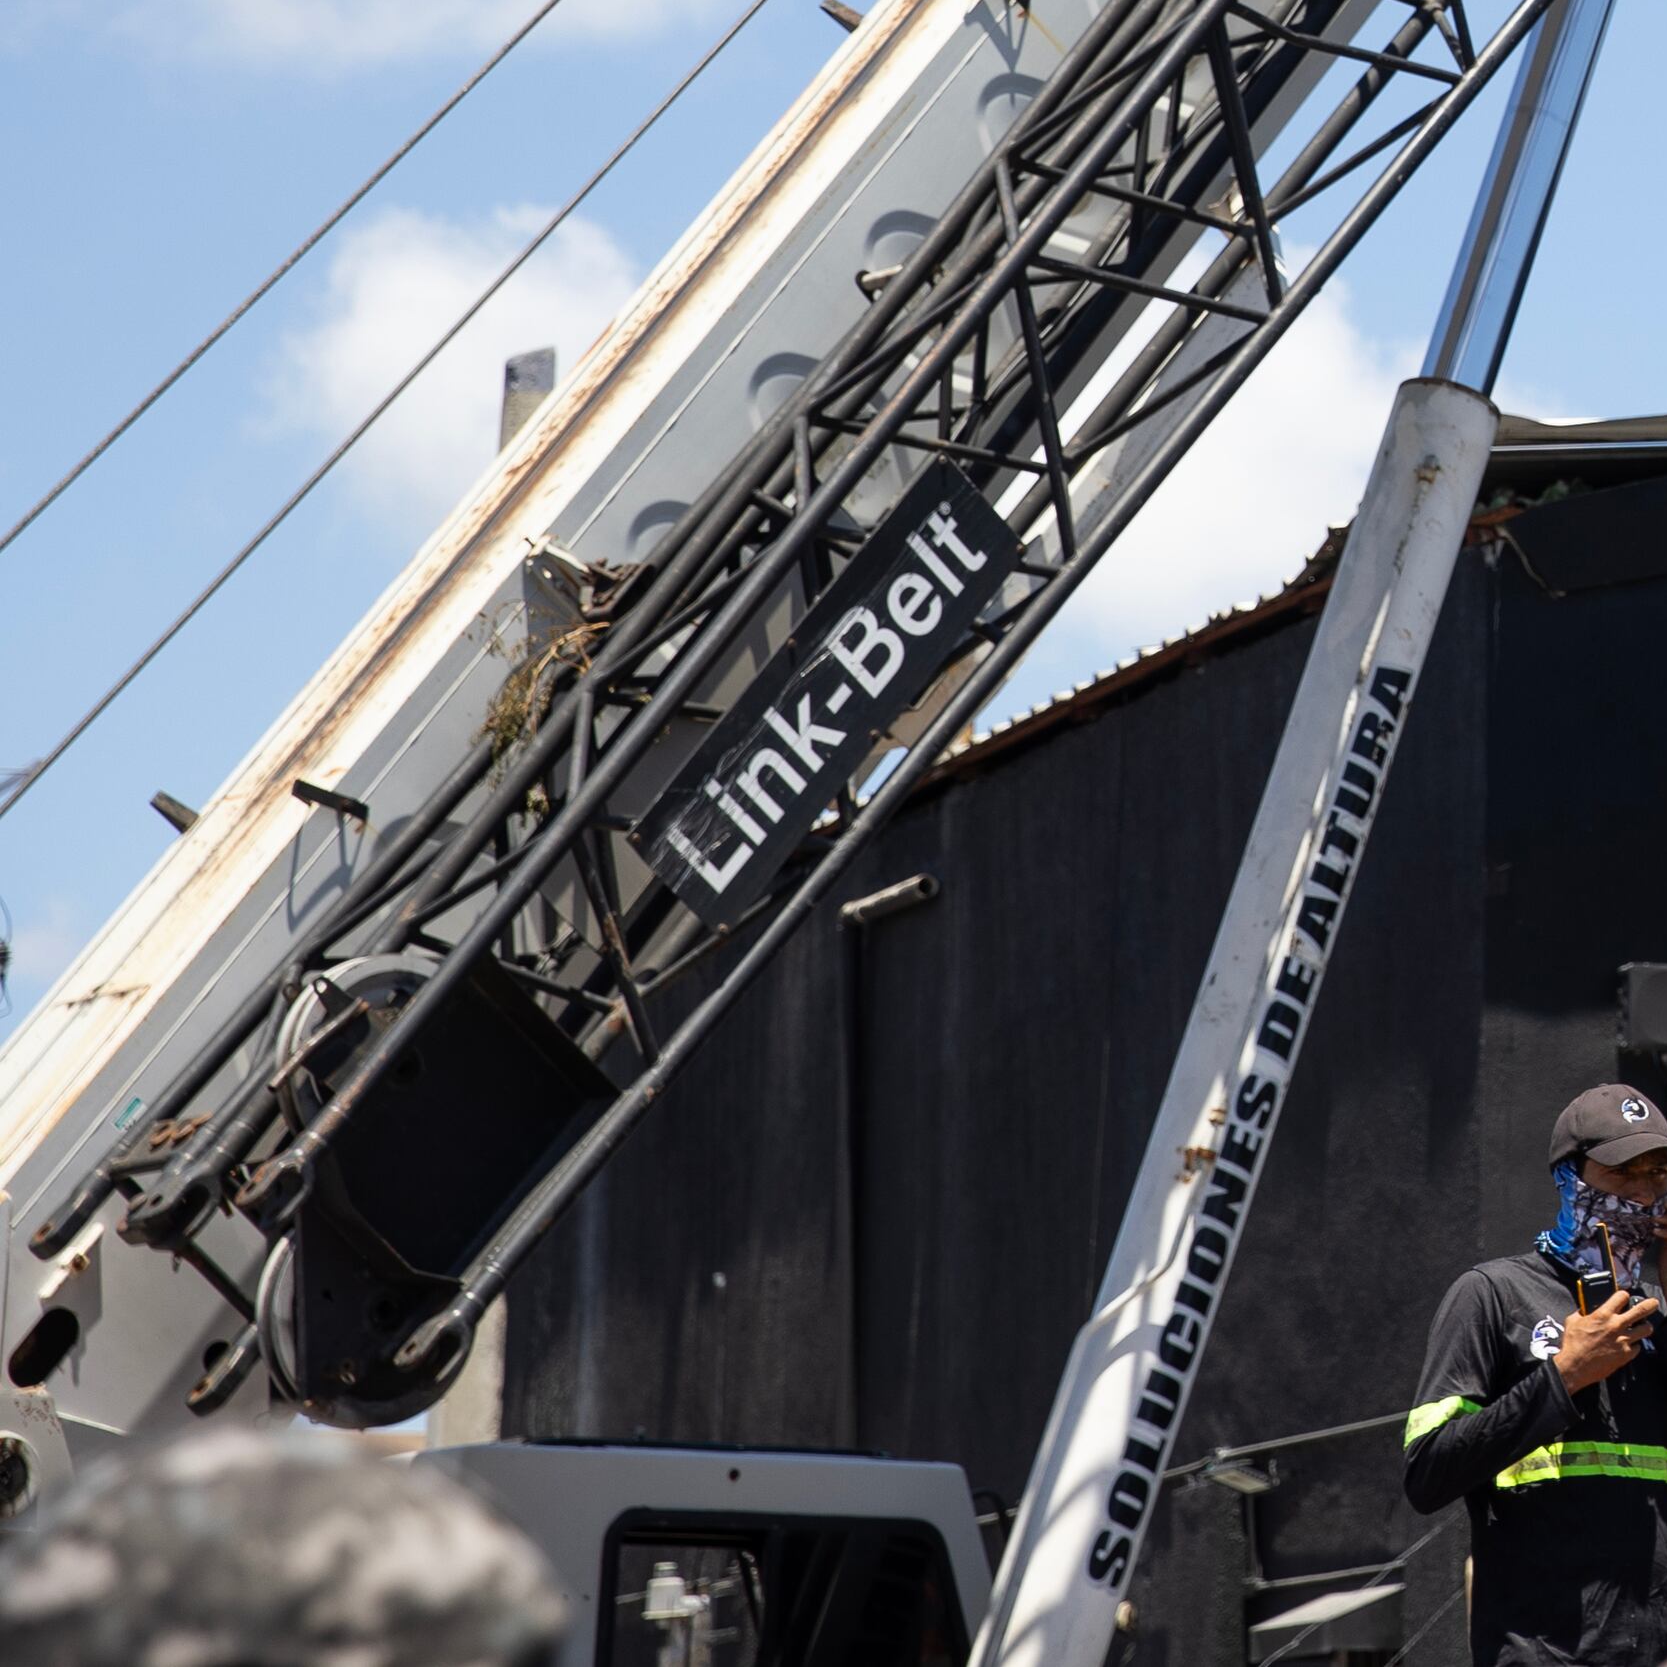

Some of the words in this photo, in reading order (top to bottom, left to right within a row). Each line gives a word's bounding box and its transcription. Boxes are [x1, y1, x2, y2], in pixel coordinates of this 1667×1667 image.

[668, 510, 988, 894] Link-Belt
[1088, 1074, 1279, 1588] SOLUCIONES
[1257, 955, 1317, 1061] DE
[1296, 666, 1412, 951] ALTURA
